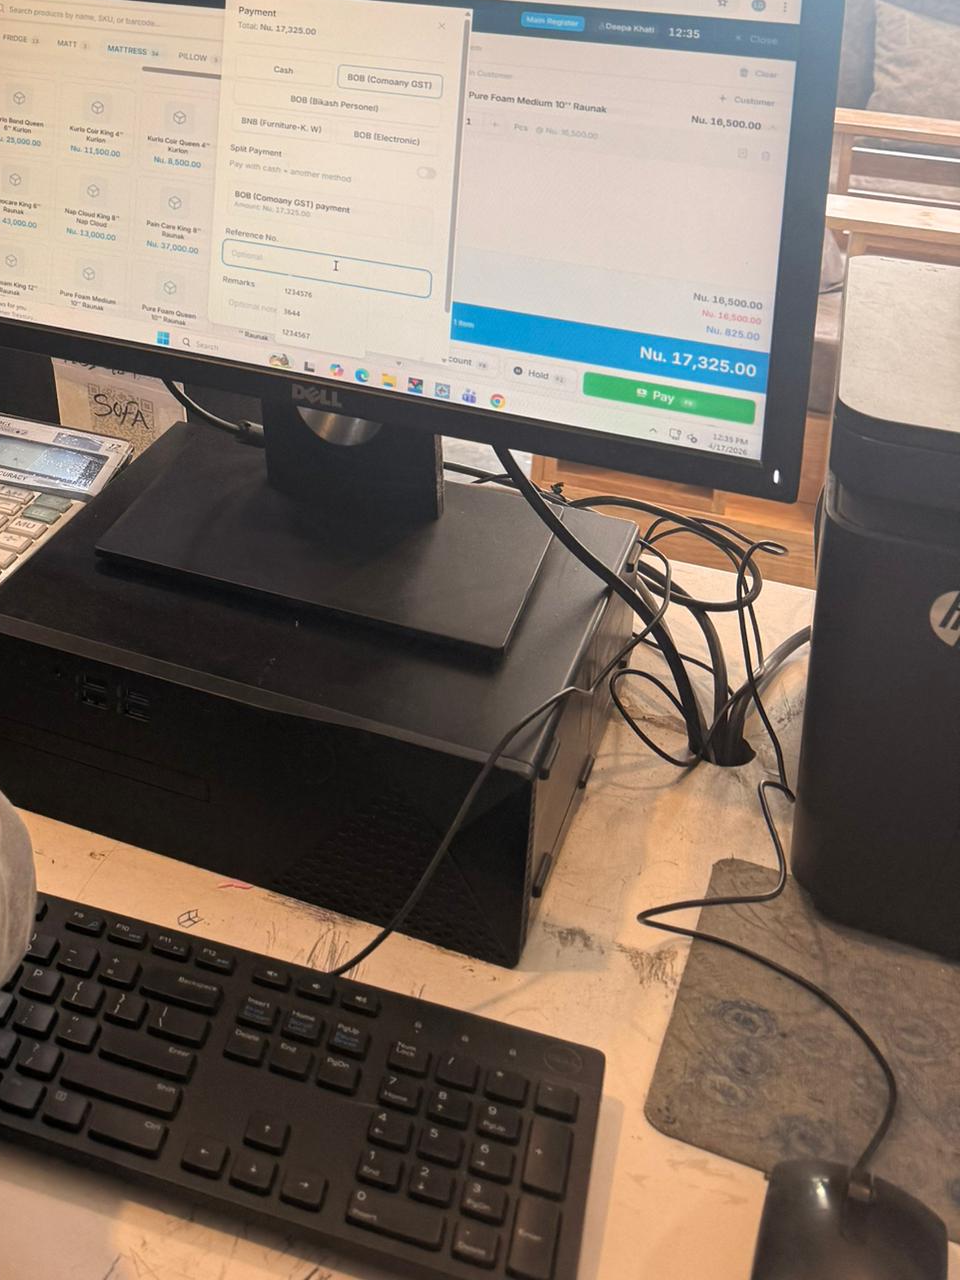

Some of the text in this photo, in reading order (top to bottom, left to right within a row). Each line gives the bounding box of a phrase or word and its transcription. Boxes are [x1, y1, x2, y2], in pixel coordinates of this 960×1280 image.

[9, 6, 64, 19] Search products
[238, 6, 276, 18] Payment
[238, 21, 316, 36] Total: Nu. 17,325.00
[605, 22, 632, 32] Deepa
[2, 34, 28, 43] FRIDGE
[668, 28, 700, 39] 12:35
[57, 40, 77, 48] MATT
[106, 44, 147, 56] MATTRESS
[178, 52, 208, 62] PILLOW
[274, 66, 294, 75] Cash
[348, 73, 365, 82] BOB
[411, 79, 432, 90] GST)
[290, 95, 308, 104] BOB
[309, 97, 338, 109] (Bikash
[468, 91, 607, 113] Pure Foam Medium Raunak
[734, 96, 775, 106] Customer
[25, 120, 44, 128] Queen
[241, 117, 322, 134] BNB W)
[691, 116, 762, 130] Nu. 16,500.00
[12, 126, 32, 134] Kurlon
[100, 130, 114, 138] King
[86, 136, 106, 144] Kurlon
[354, 130, 420, 146] BOB (Electronic)
[168, 146, 188, 154] Kurlon
[179, 140, 200, 149] Queen
[230, 144, 282, 158] Split Payment
[229, 160, 352, 183] Pay with cash another method
[19, 201, 32, 209] King
[234, 190, 252, 200] BOB
[294, 198, 314, 210] GST)
[315, 202, 350, 214] payment
[3, 206, 24, 215] Raunak
[64, 208, 110, 221] Nap Cloud King
[76, 218, 107, 228] Nap Cloud
[147, 220, 192, 234] Pain Care King
[162, 231, 184, 240] Raunak
[226, 228, 278, 242] Reference No.
[13, 282, 27, 290] King
[222, 276, 255, 288] Remarks
[60, 289, 116, 305] Pure Foam Medium
[693, 292, 763, 310] Nu. 16,500.00
[82, 302, 104, 312] Raunak
[142, 304, 196, 319] Pure Foam Queen
[162, 316, 186, 326] Raunak
[706, 326, 760, 340] Nu. 825.00
[640, 346, 756, 377] Nu. 17,325.00
[528, 370, 549, 380] Hold
[290, 384, 342, 408] DELL
[652, 390, 675, 404] Pay
[734, 436, 748, 444] PM
[14, 520, 36, 530] MU
[159, 936, 172, 944] F11
[178, 976, 218, 992] Backspace
[248, 996, 270, 1008] Insert
[292, 1010, 316, 1021] Home
[338, 1023, 360, 1035] PgUp
[235, 1028, 260, 1042] Delete
[168, 1046, 190, 1057] Enter
[280, 1042, 297, 1053] End
[327, 1057, 350, 1069] PgDn
[390, 1076, 398, 1084] 7
[156, 1083, 176, 1094] Shift
[384, 1090, 408, 1102] Home
[438, 1092, 447, 1100] 8
[488, 1106, 497, 1115] 9
[378, 1112, 387, 1121] 4
[144, 1120, 161, 1131] Ctrl
[430, 1128, 438, 1138] 5
[480, 1144, 489, 1154] 6
[420, 1167, 429, 1176] 2
[473, 1184, 481, 1193] 3
[518, 1228, 542, 1240] Enter
